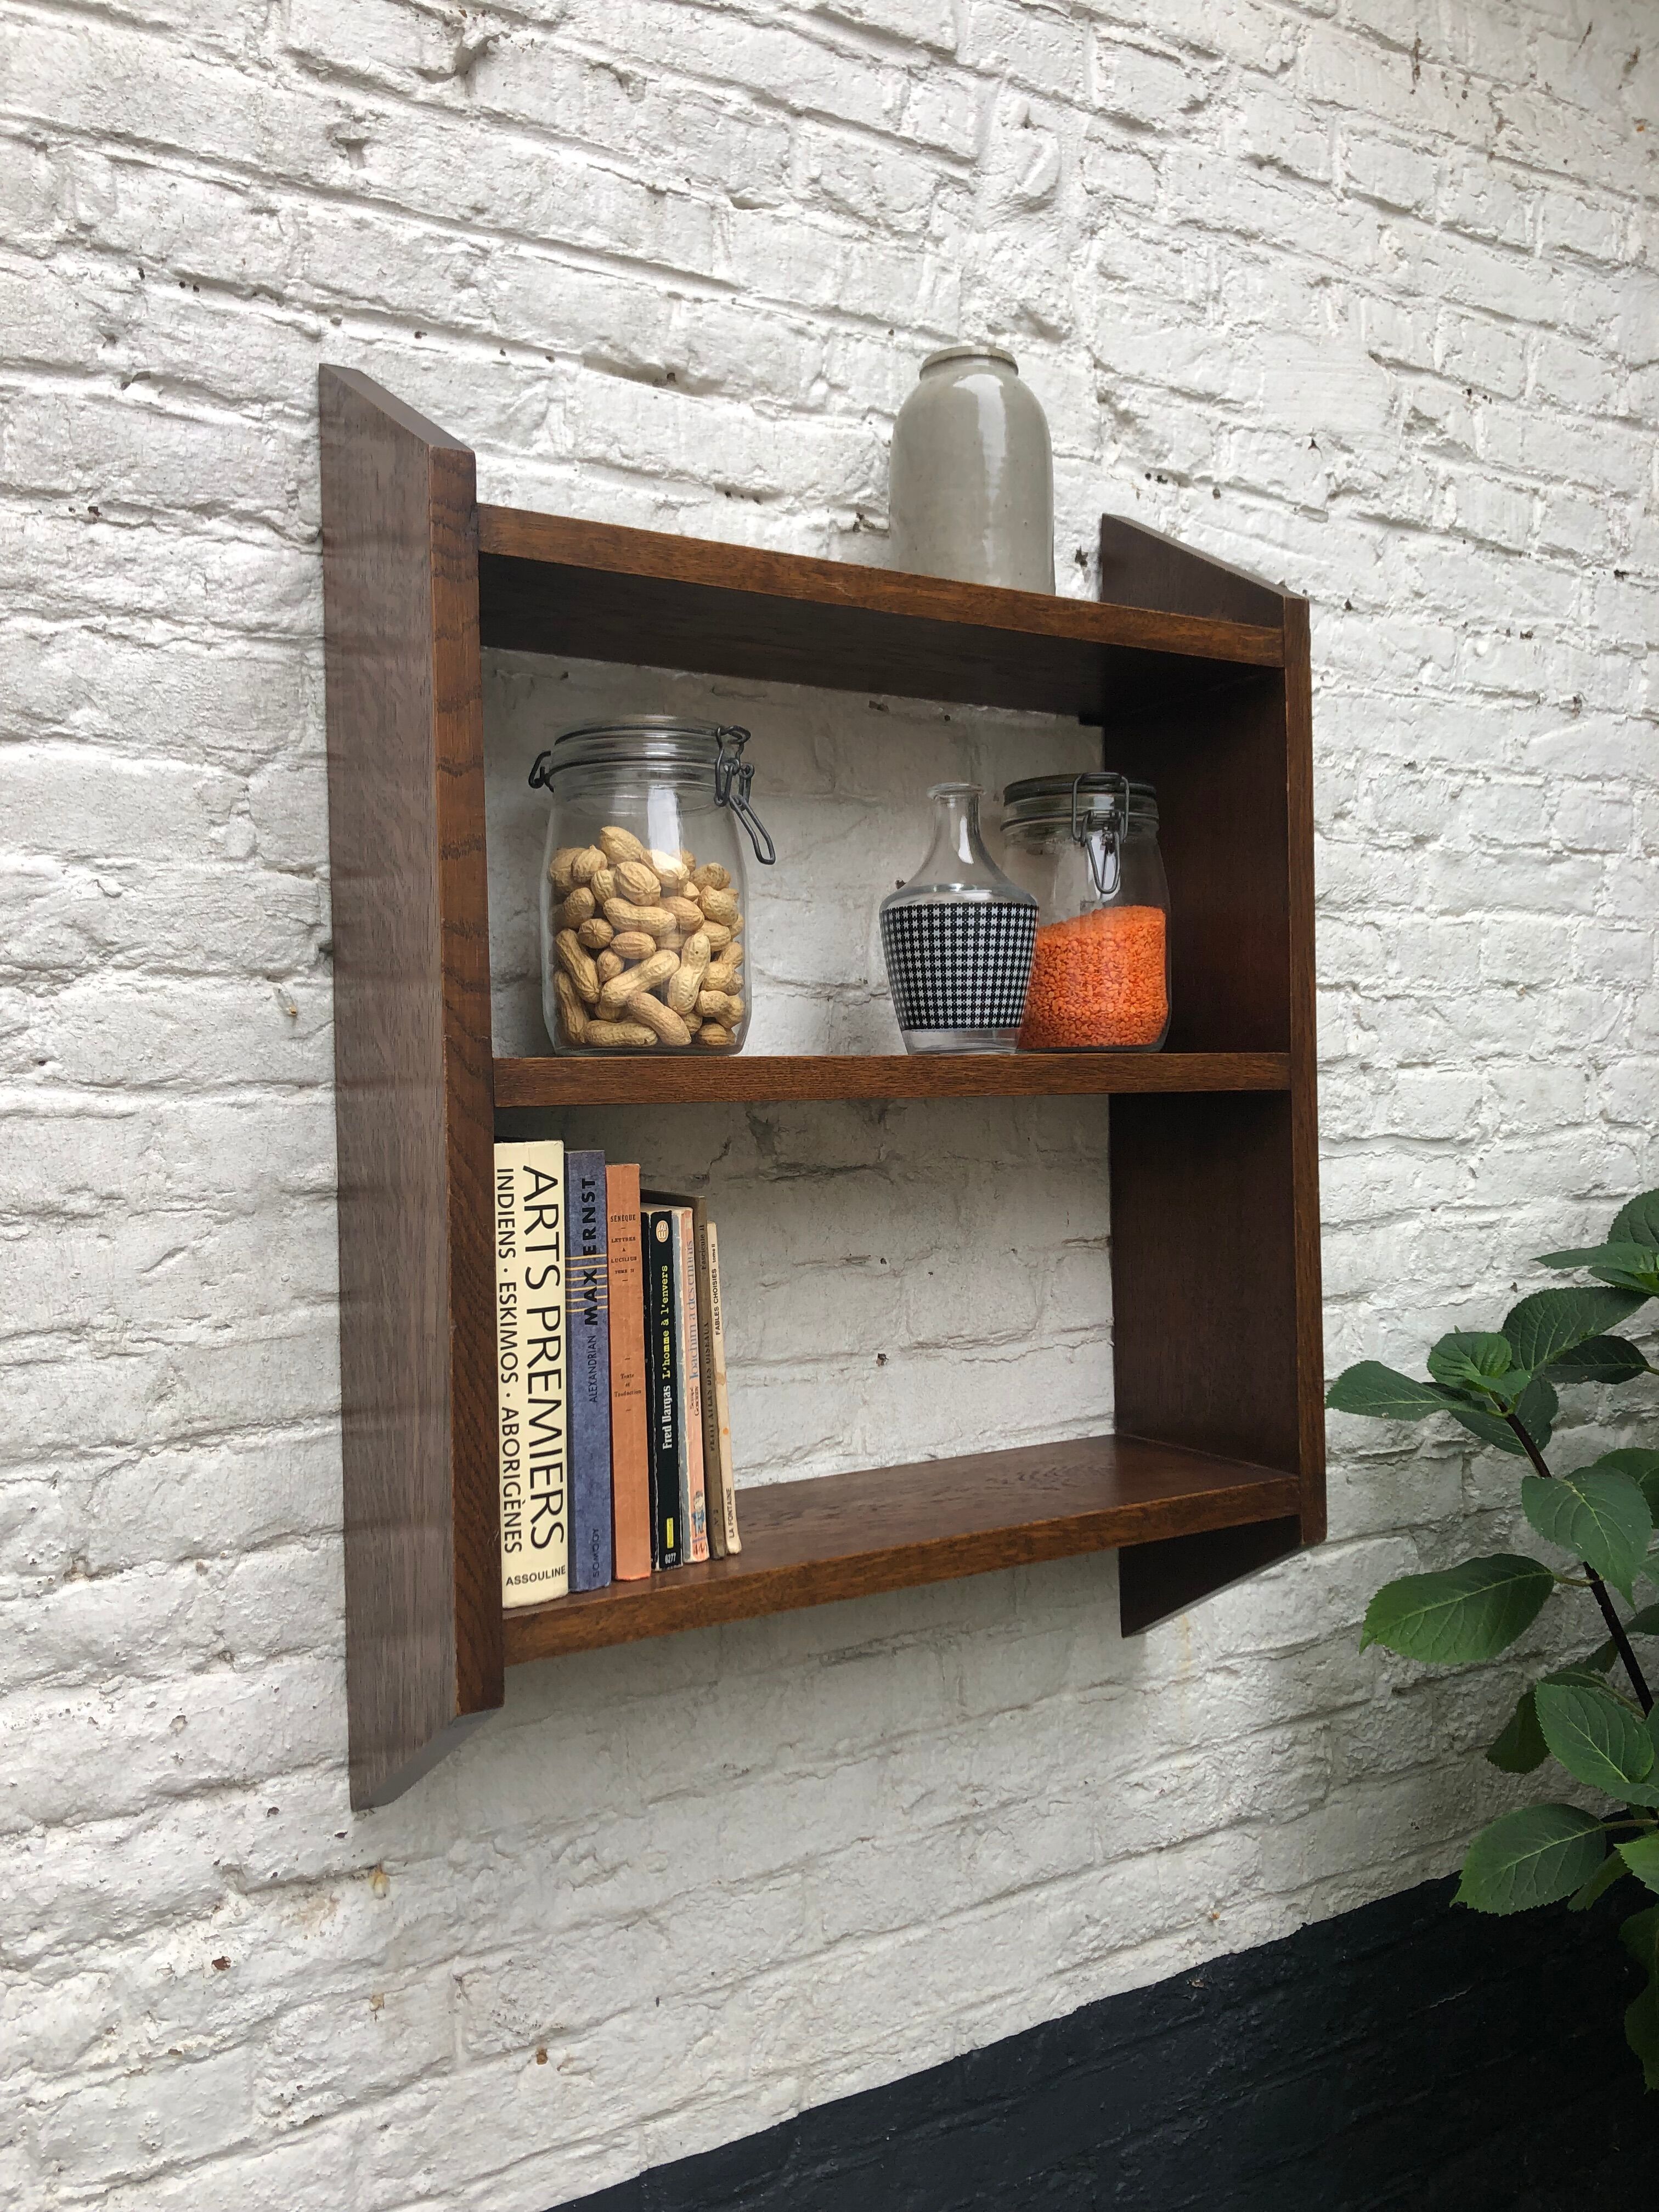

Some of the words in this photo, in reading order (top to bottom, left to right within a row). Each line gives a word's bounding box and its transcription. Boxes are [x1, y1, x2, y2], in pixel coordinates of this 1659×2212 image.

[496, 1169, 516, 1259] INDIENS
[523, 1165, 560, 1289] ARTS
[582, 1178, 597, 1256] ERNST
[658, 1231, 667, 1239] LU
[584, 1269, 598, 1326] MAX
[661, 1265, 669, 1315] l'envers
[687, 1288, 696, 1310] des
[499, 1282, 518, 1383] ESKIMOS
[662, 1330, 670, 1380] L'homme
[689, 1324, 698, 1380] Joachim
[588, 1335, 597, 1403] ALEXANDRIAN
[614, 1389, 642, 1397] Traduction
[526, 1305, 565, 1549] PREMIERS
[662, 1385, 673, 1424] Vargas
[662, 1425, 673, 1450] Fred
[501, 1407, 526, 1554] ABORIGÈNES
[726, 1487, 734, 1526] FONTAINE
[729, 1529, 735, 1538] LA
[505, 1565, 566, 1587] ASSOULINE
